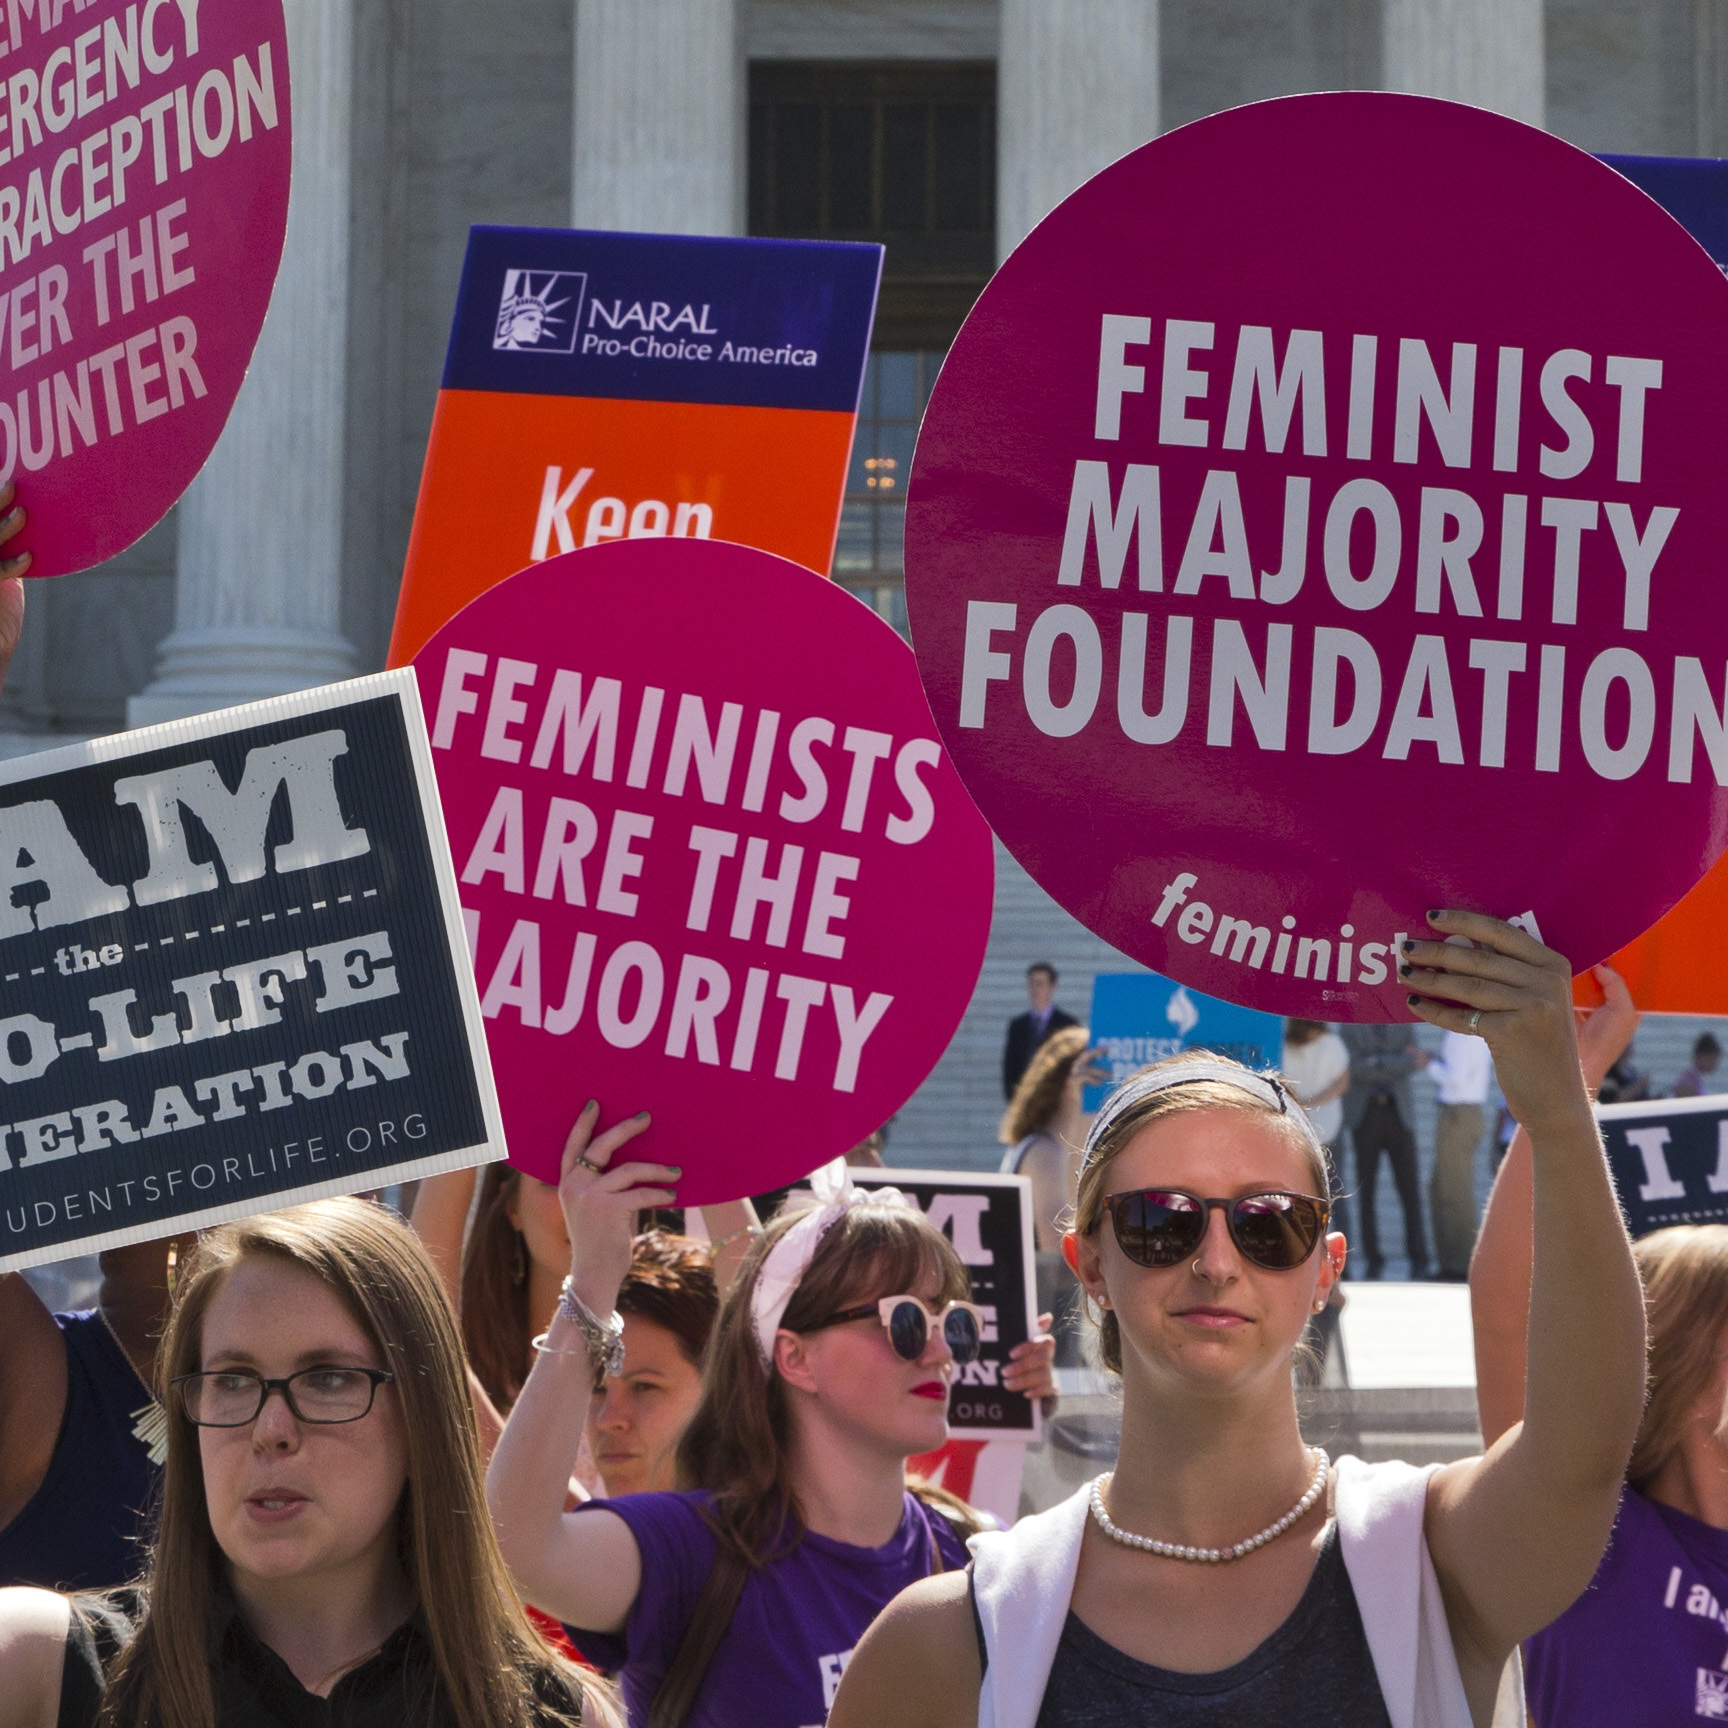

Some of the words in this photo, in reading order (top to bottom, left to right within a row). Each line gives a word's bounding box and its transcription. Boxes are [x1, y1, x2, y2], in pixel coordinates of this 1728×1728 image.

[81, 197, 197, 328] THE
[588, 298, 718, 335] NARAL
[581, 334, 712, 362] Pro-Choice
[717, 340, 818, 368] America
[1094, 313, 1664, 483] FEMINIST
[1057, 459, 1681, 632] MAJORITY
[431, 646, 942, 845] FEMINISTS
[460, 785, 655, 917] ARE
[685, 824, 861, 960] THE
[54, 941, 124, 978] the
[463, 907, 895, 1094] AJORITY
[1624, 1126, 1687, 1202] I
[1664, 1566, 1682, 1609] I
